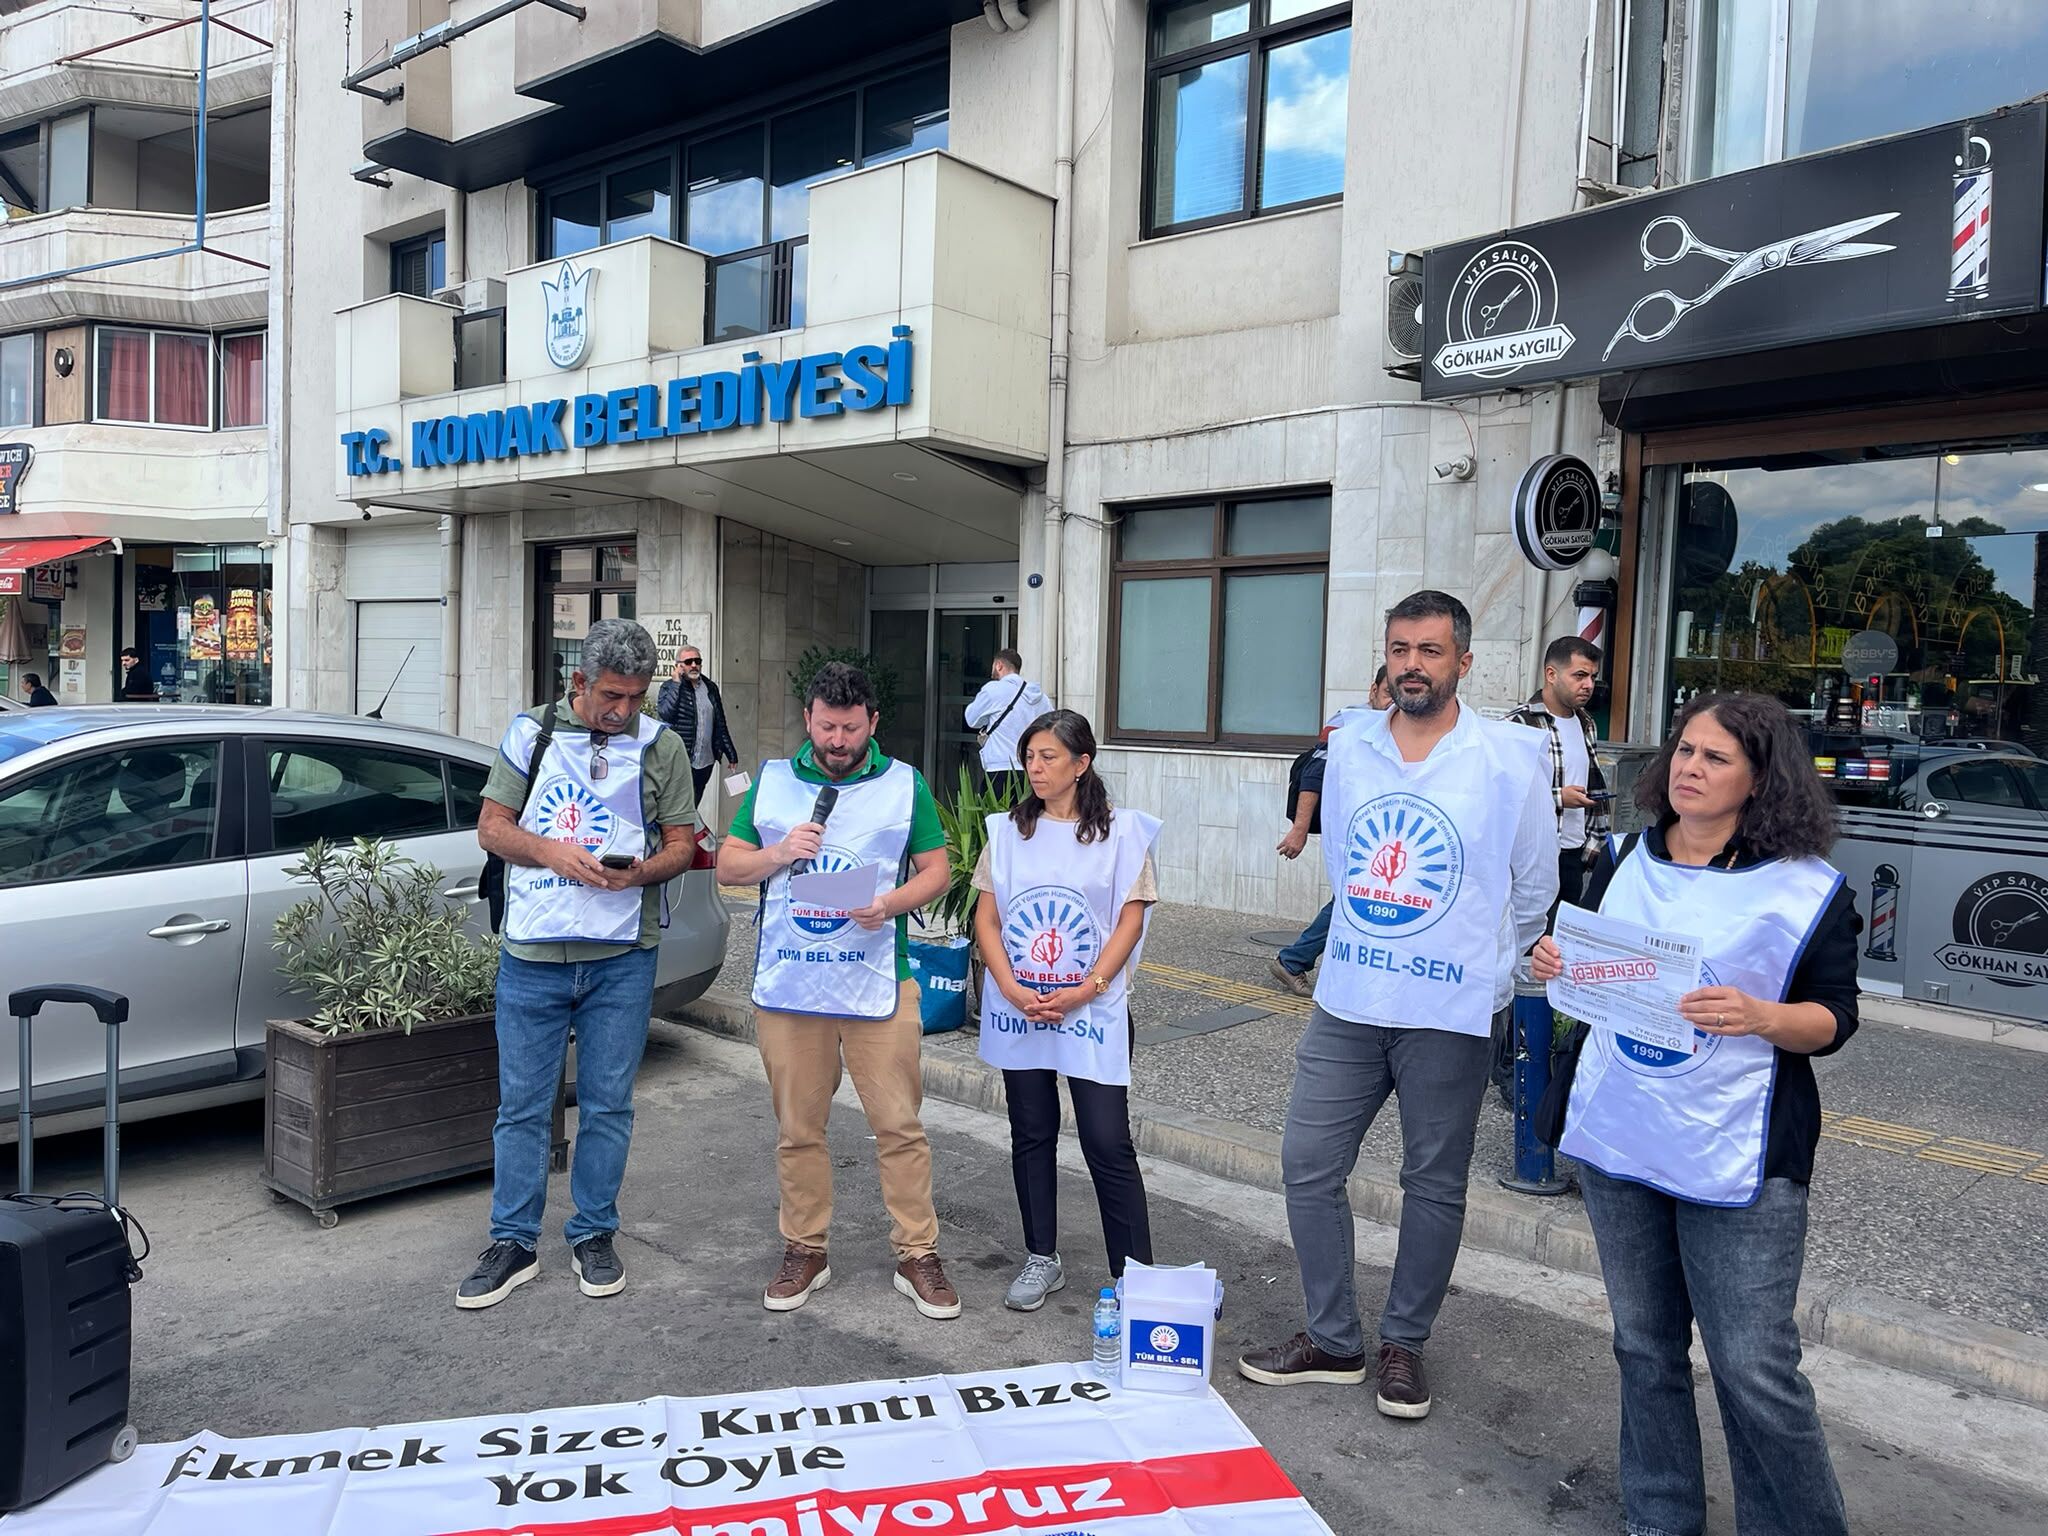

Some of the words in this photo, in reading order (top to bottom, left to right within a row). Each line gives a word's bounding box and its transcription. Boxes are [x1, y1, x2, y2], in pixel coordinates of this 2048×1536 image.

[1464, 260, 1487, 286] VIP
[1491, 250, 1539, 273] SALON
[1442, 346, 1504, 369] GÖKHAN
[1508, 336, 1563, 359] SAYGILI
[411, 397, 569, 468] KONAK
[574, 324, 913, 449] BELEDİYESİ
[1551, 477, 1564, 491] VIP
[1565, 473, 1588, 491] SALON
[1545, 536, 1570, 545] GÖKHAN
[1571, 534, 1591, 544] SAYGILI
[657, 631, 688, 646] İZMİR
[1401, 798, 1440, 822] Hizmetleri
[1436, 819, 1457, 862] Emekçileri
[1440, 863, 1459, 904] Sendikası
[1973, 878, 2000, 897] VIP
[1021, 890, 1050, 904] Yönetim
[1051, 891, 1085, 908] Hizmetleri
[1347, 884, 1370, 897] TÜM
[1374, 890, 1433, 909] BEL-SEN
[792, 908, 811, 916] TÜM
[813, 909, 848, 917] BEL-SE
[1366, 904, 1398, 919] 1990
[809, 920, 832, 929] 1990
[777, 947, 801, 961] TÜM
[805, 951, 834, 962] BEL
[839, 951, 865, 962] SEN
[1357, 944, 1464, 984] BEL-SEN
[1944, 951, 2018, 974] GÖKHAN
[1039, 973, 1084, 983] BEL-SE
[1571, 960, 1657, 980] ÖDENEMEDİ
[990, 1012, 1028, 1035] TÜM
[1631, 1044, 1664, 1062] 1990
[1135, 1352, 1155, 1361] TÜM
[1156, 1354, 1174, 1363] BEL
[1180, 1356, 1199, 1365] SEN
[160, 1438, 448, 1488] Ekmek
[476, 1423, 668, 1459] Size,
[698, 1392, 937, 1440] Kırıntı
[955, 1379, 1112, 1414] Bize
[484, 1463, 634, 1507] Yok
[659, 1445, 846, 1493] Öyle
